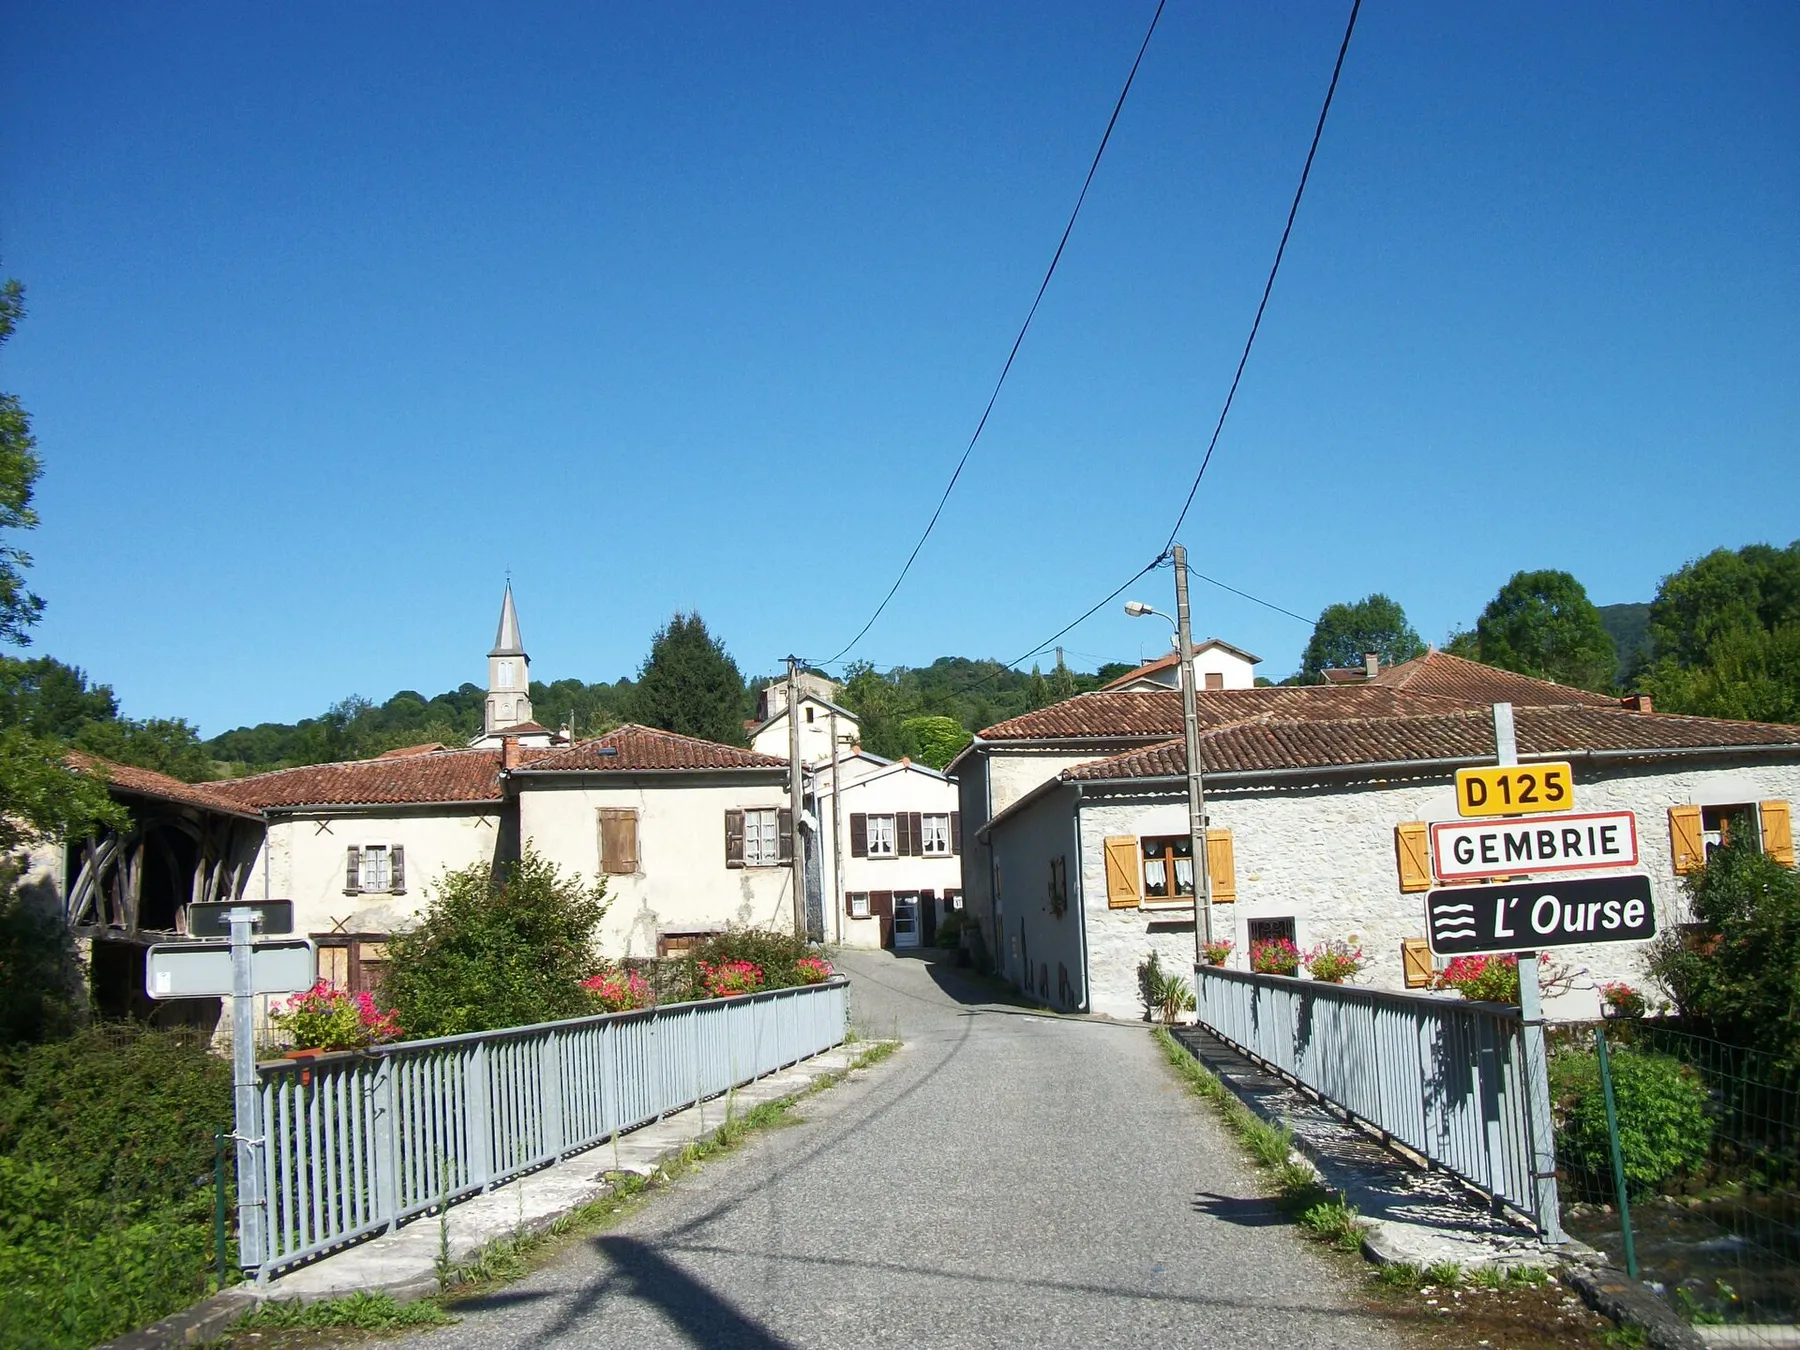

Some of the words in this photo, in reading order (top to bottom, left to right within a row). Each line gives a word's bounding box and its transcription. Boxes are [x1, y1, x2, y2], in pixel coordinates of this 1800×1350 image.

[1466, 777, 1488, 807] D
[1496, 772, 1565, 805] 125
[1453, 825, 1620, 865] GEMBRIE
